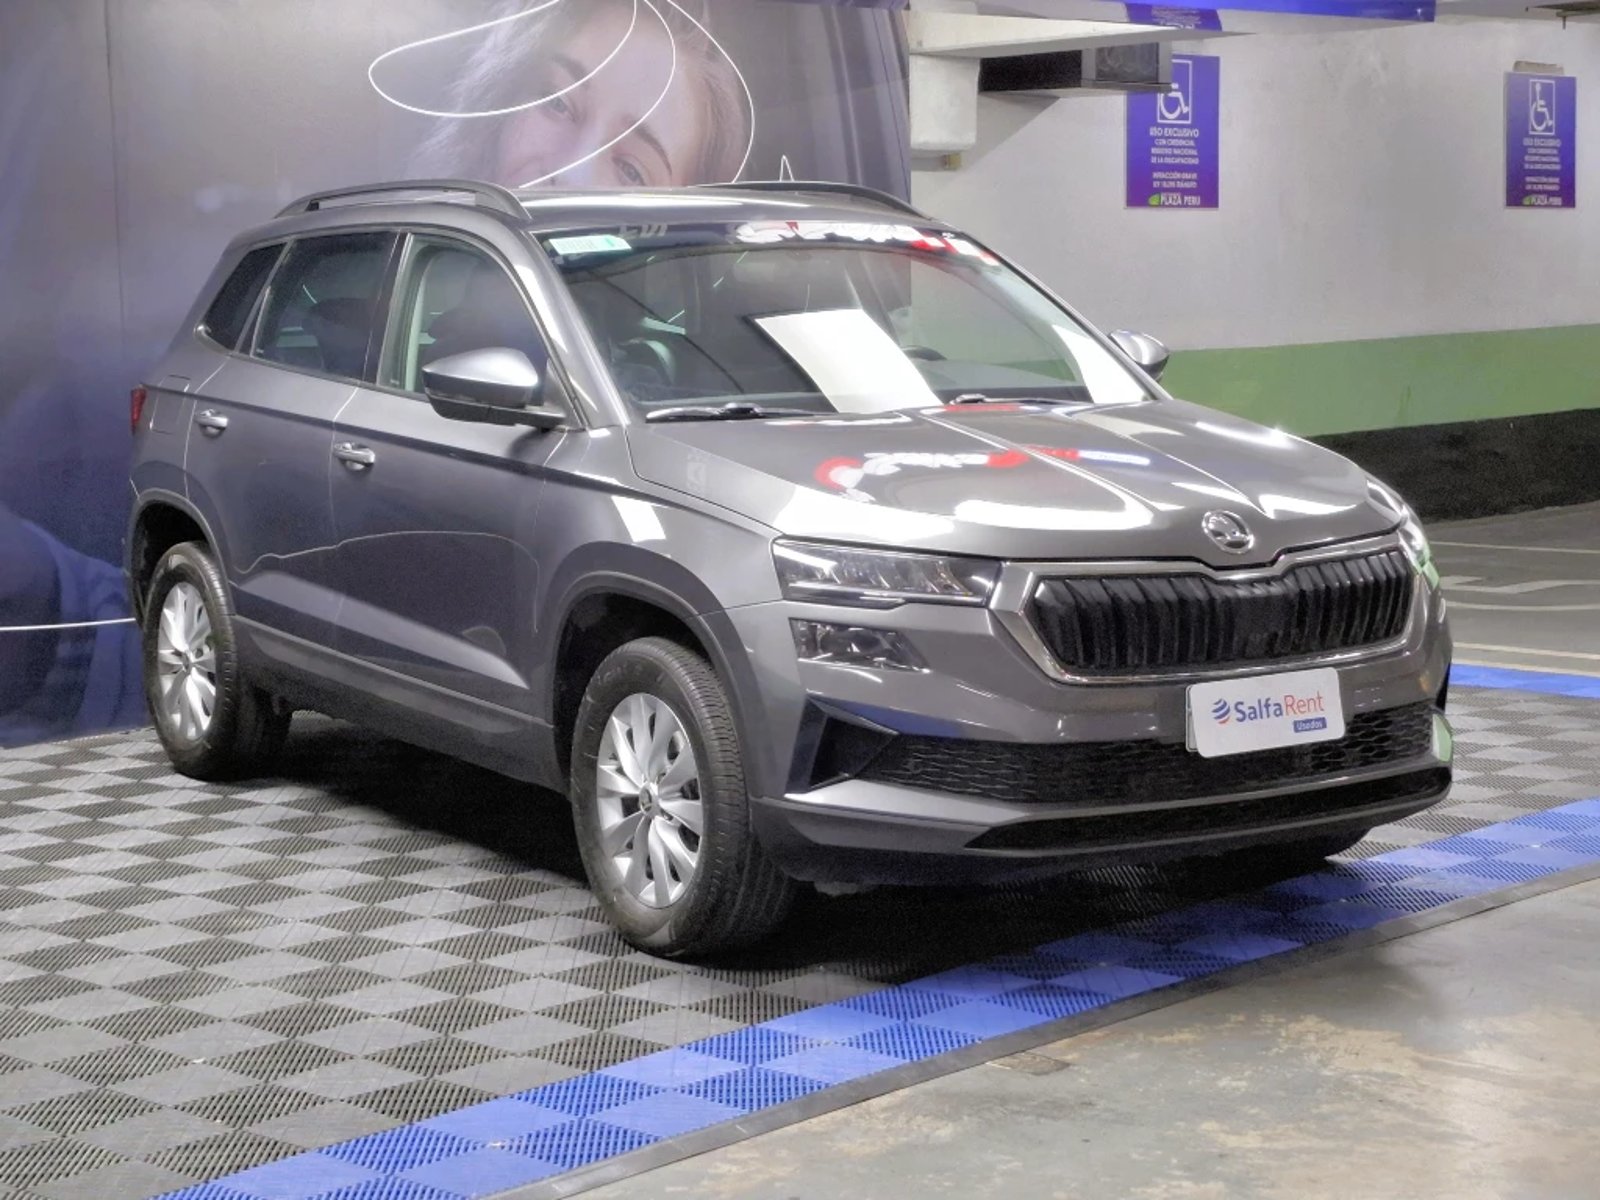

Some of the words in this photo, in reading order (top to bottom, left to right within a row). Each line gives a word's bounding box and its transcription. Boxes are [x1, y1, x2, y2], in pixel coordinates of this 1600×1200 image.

[1164, 128, 1200, 138] EXCLUSIVO
[1160, 194, 1182, 205] PLAZA
[1234, 690, 1325, 723] SalfaRent
[1297, 720, 1322, 730] Usados
